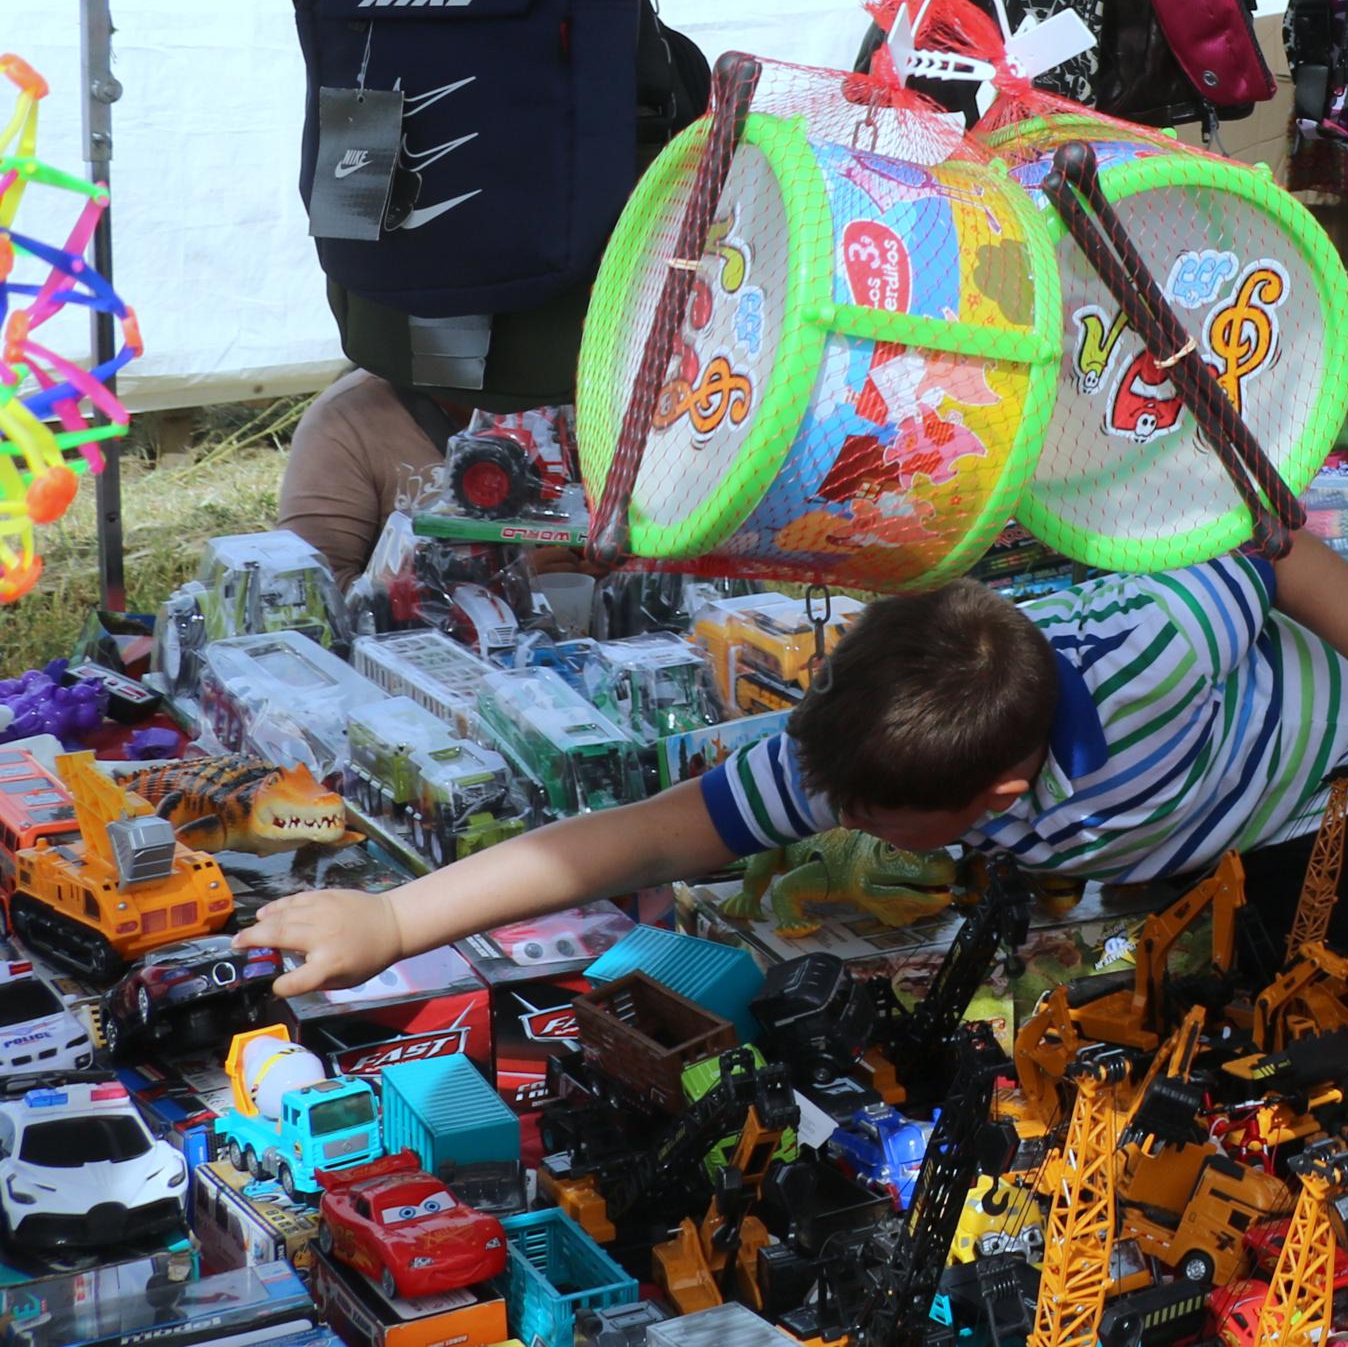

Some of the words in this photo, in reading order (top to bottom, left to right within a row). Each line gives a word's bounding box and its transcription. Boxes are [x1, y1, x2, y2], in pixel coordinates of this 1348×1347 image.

[343, 149, 369, 166] NIKE
[881, 238, 900, 313] erditos
[501, 527, 572, 542] WORLD
[4, 1032, 52, 1048] POLICE
[350, 1036, 456, 1073] FAST
